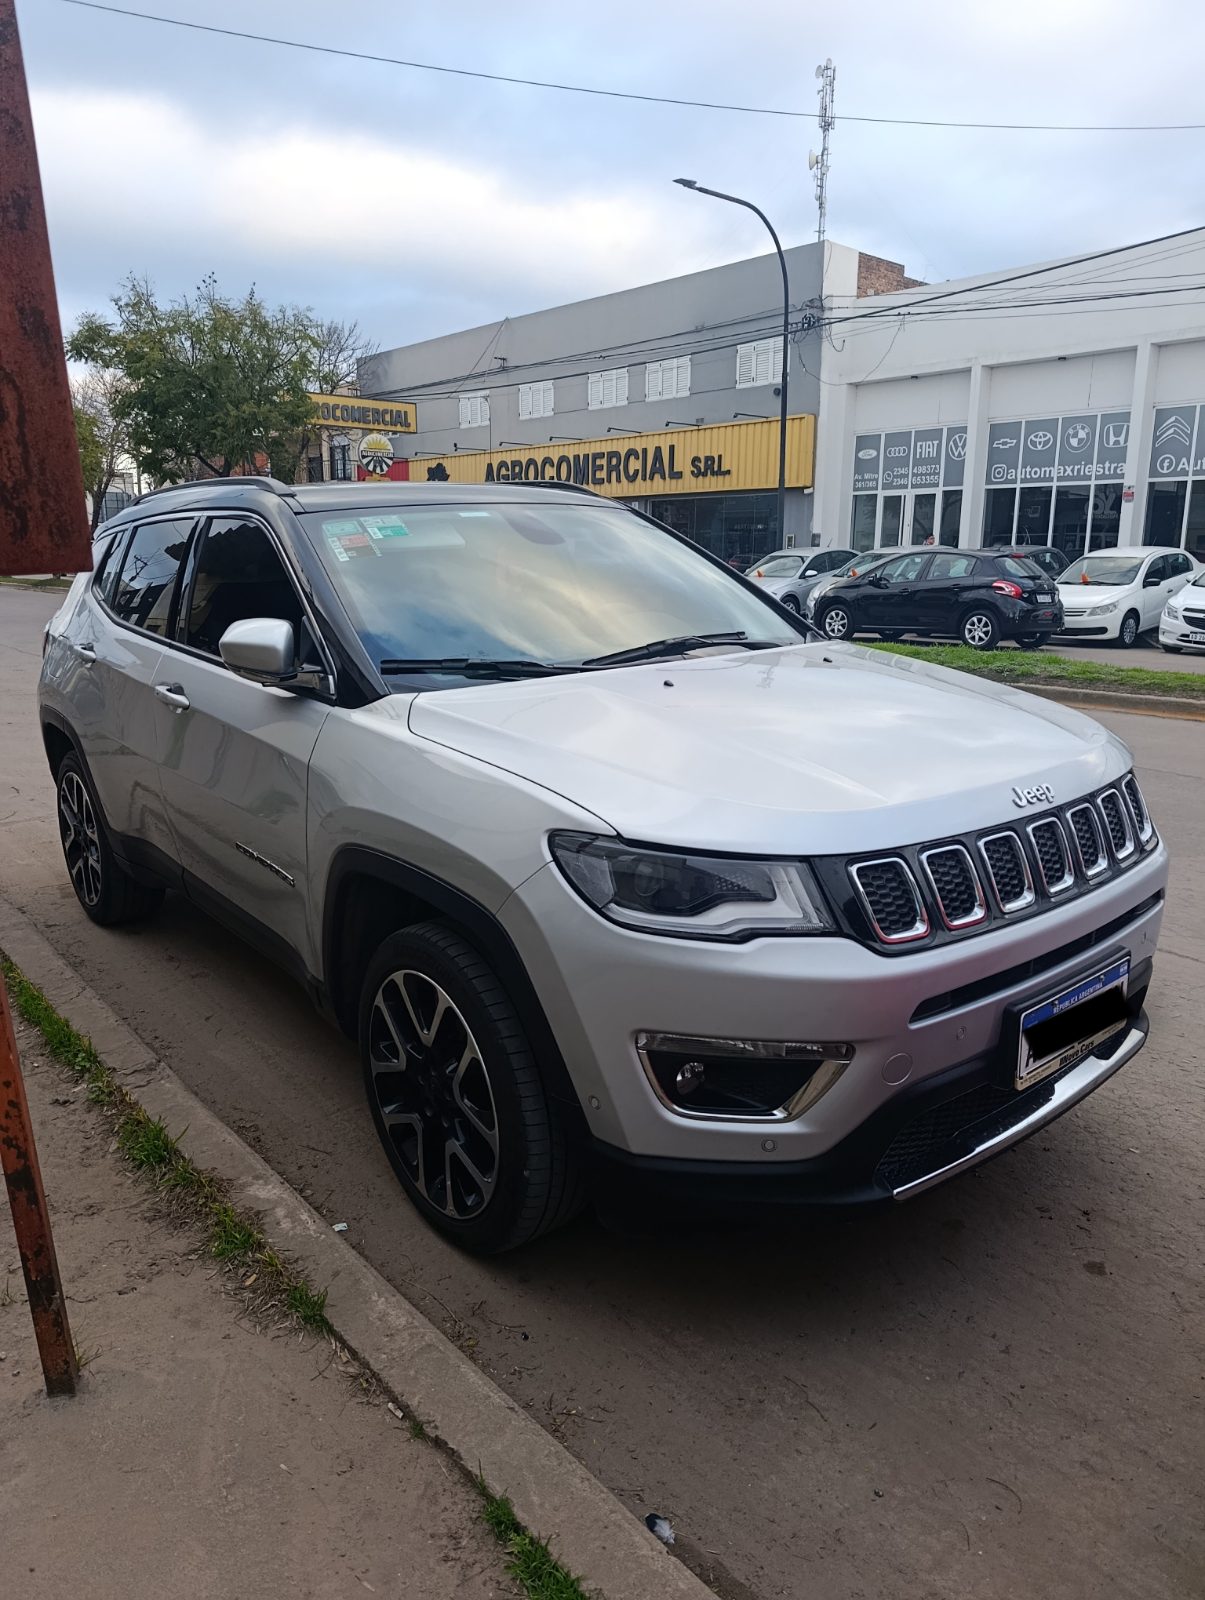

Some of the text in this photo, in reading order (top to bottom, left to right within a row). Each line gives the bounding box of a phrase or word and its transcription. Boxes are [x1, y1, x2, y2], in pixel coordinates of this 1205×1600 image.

[313, 402, 411, 428] ROCOMERCIAL
[916, 440, 940, 459] FIAT
[484, 443, 683, 486] AGROCOMERCIAL
[913, 464, 940, 474] 498373
[912, 475, 939, 485] 653355
[1011, 783, 1055, 808] Jeep
[1079, 982, 1104, 1000] ARGENTINA
